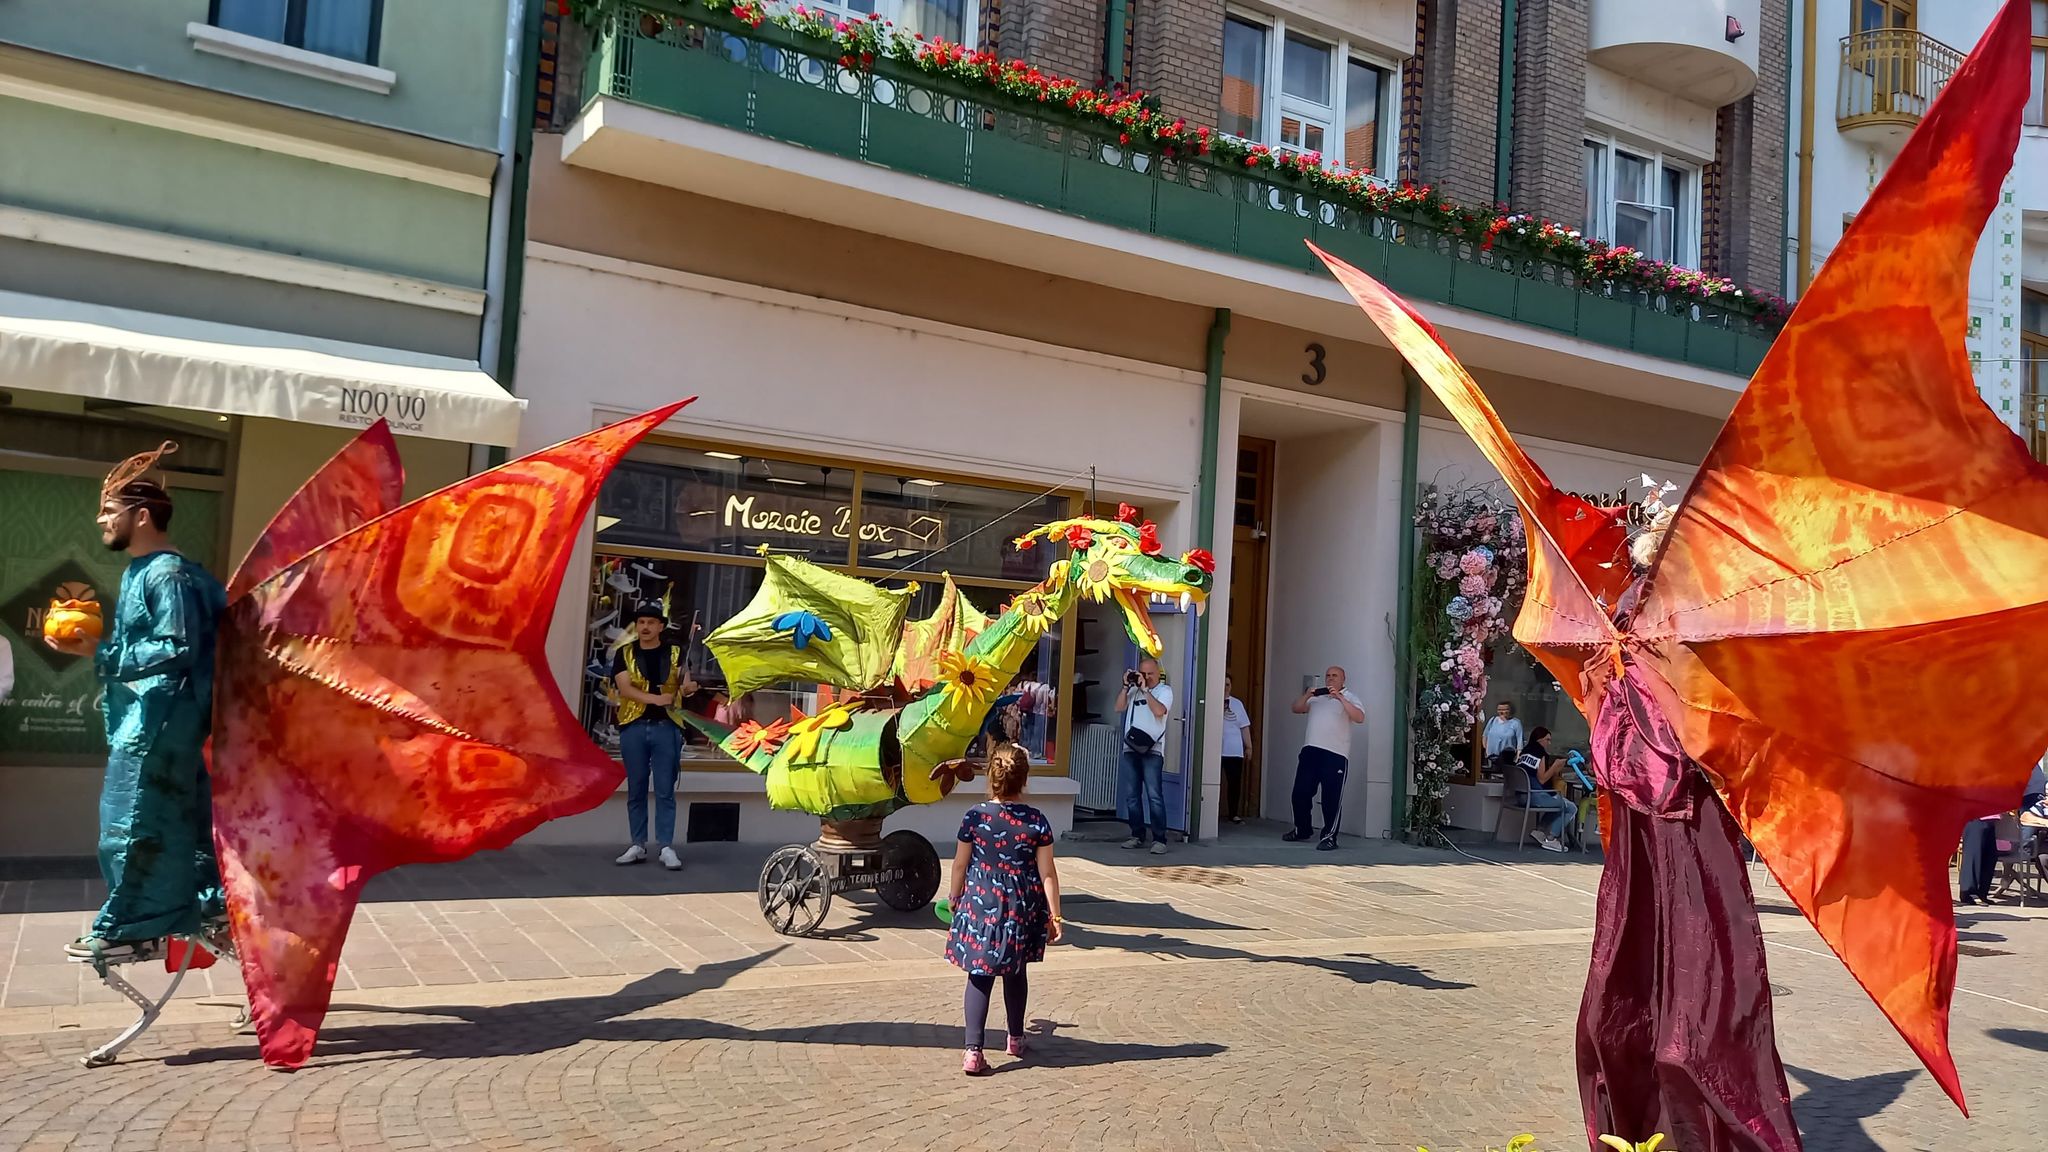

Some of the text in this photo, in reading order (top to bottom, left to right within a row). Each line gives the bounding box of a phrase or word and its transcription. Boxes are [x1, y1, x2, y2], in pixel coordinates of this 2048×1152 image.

[1301, 342, 1327, 386] 3
[338, 413, 424, 432] RESTO OUNGE
[832, 505, 894, 543] Box
